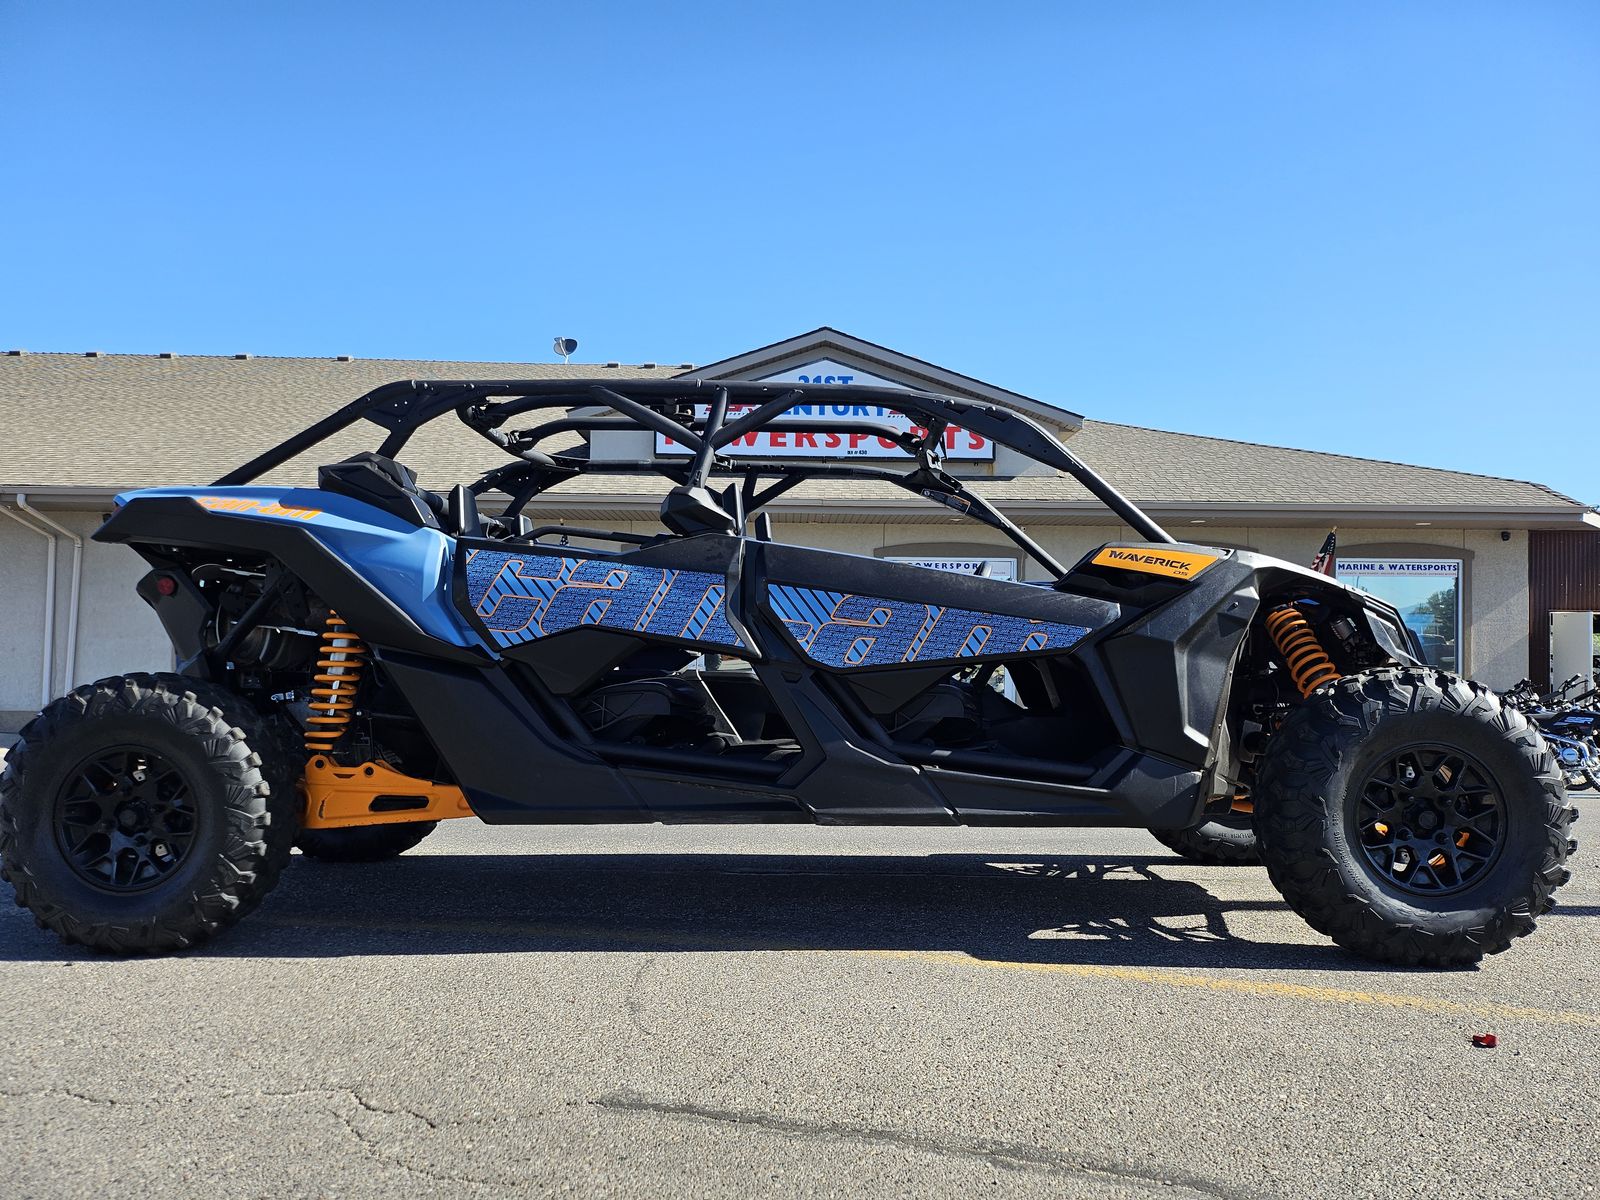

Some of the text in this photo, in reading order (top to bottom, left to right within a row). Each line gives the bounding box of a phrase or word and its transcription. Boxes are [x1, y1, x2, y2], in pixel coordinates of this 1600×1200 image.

[1109, 550, 1192, 571] MAVERICK
[1338, 563, 1375, 571] MARINE
[1378, 563, 1385, 571] &
